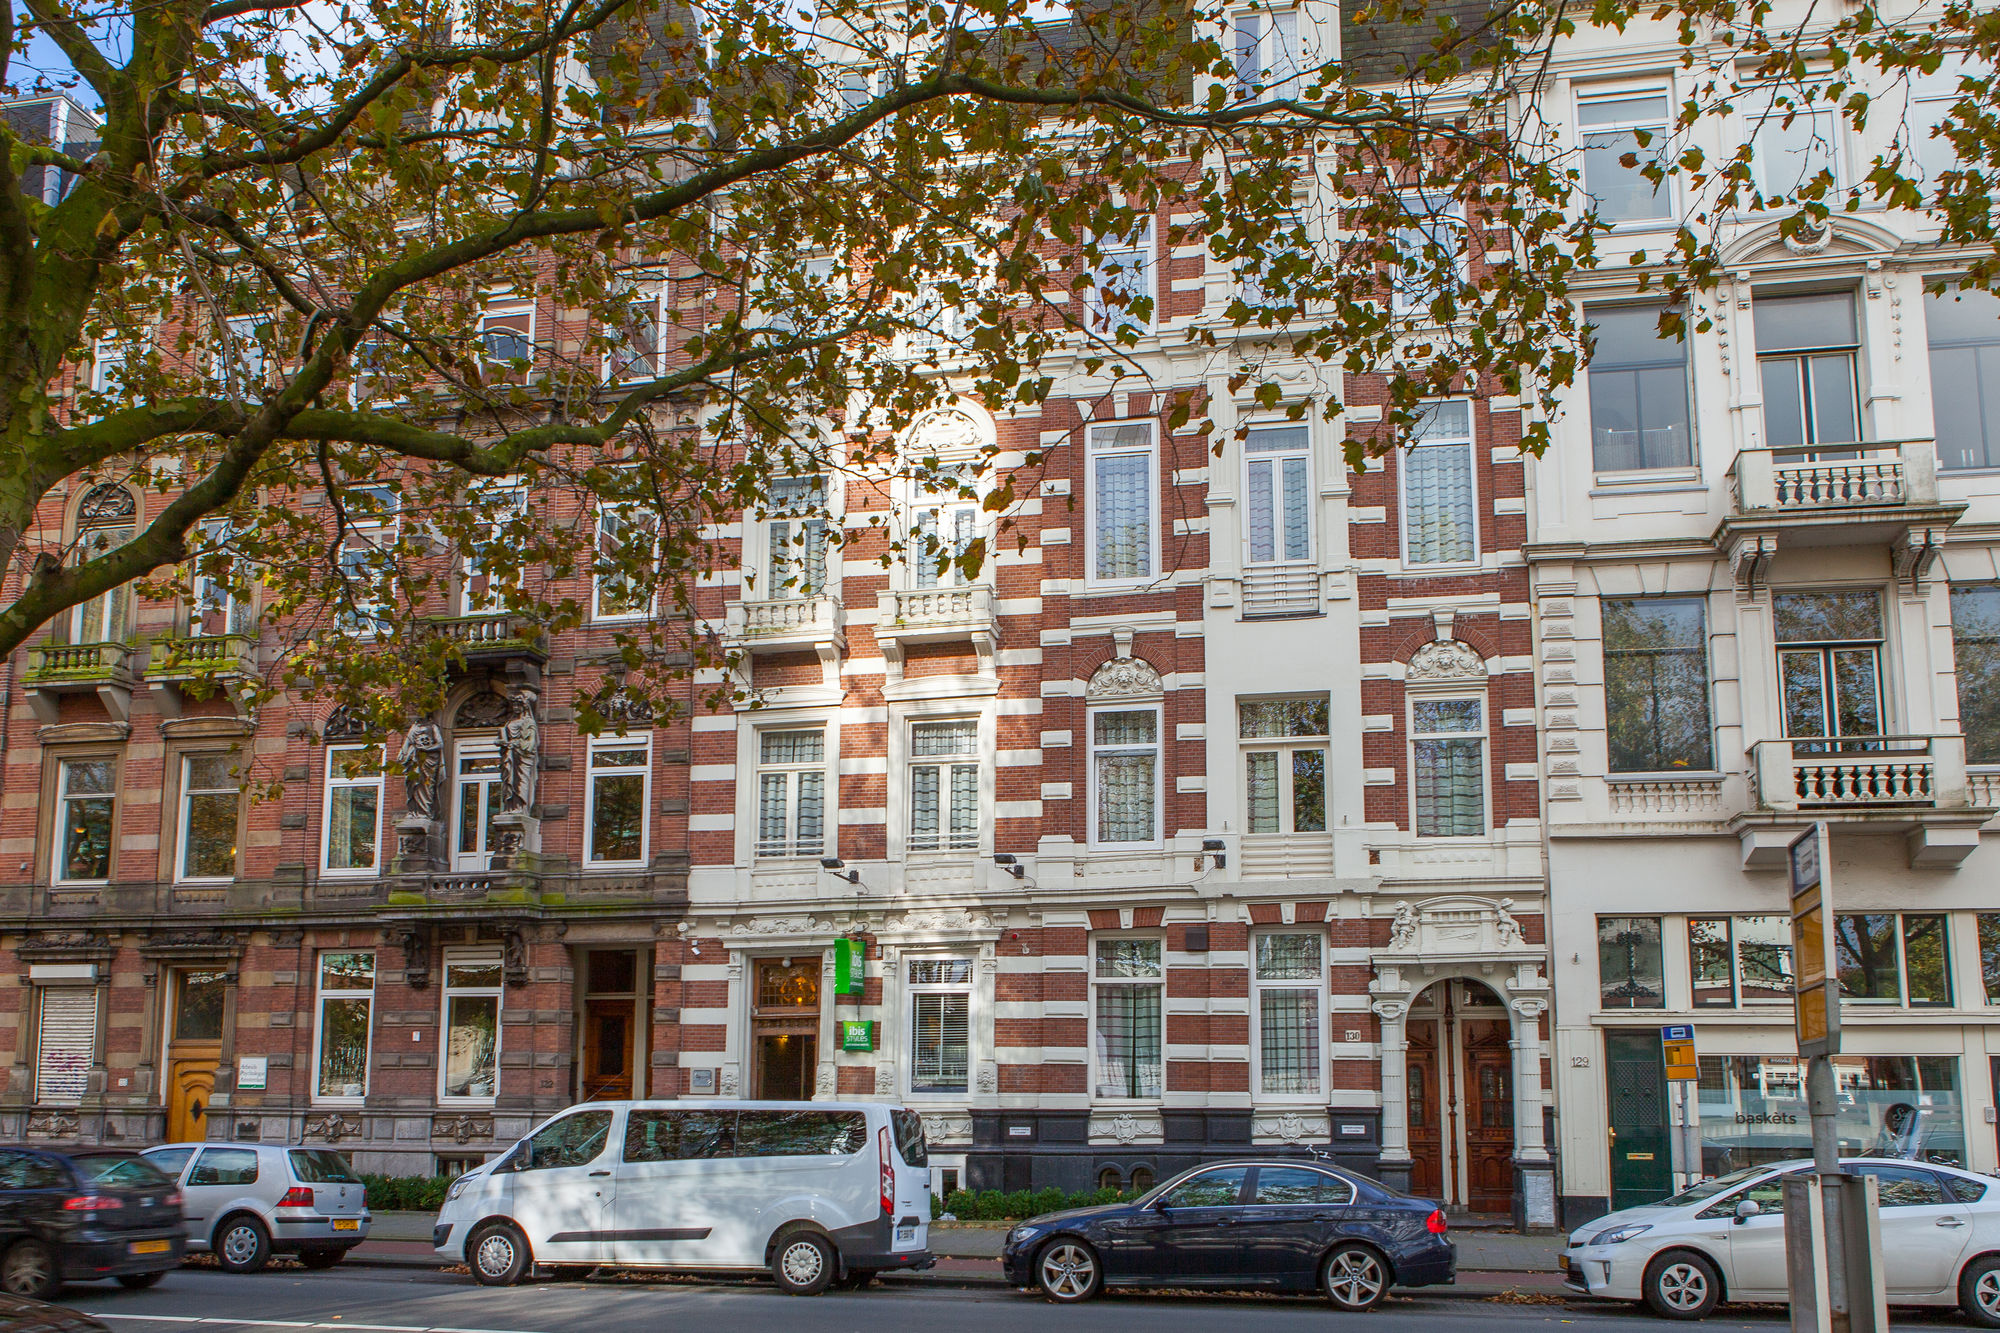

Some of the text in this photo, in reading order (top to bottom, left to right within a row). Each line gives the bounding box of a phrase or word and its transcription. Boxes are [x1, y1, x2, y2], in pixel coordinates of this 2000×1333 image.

[848, 1025, 865, 1036] ibis
[1346, 1031, 1360, 1041] 130
[1571, 1056, 1590, 1068] 129
[1735, 1111, 1797, 1124] baskèts
